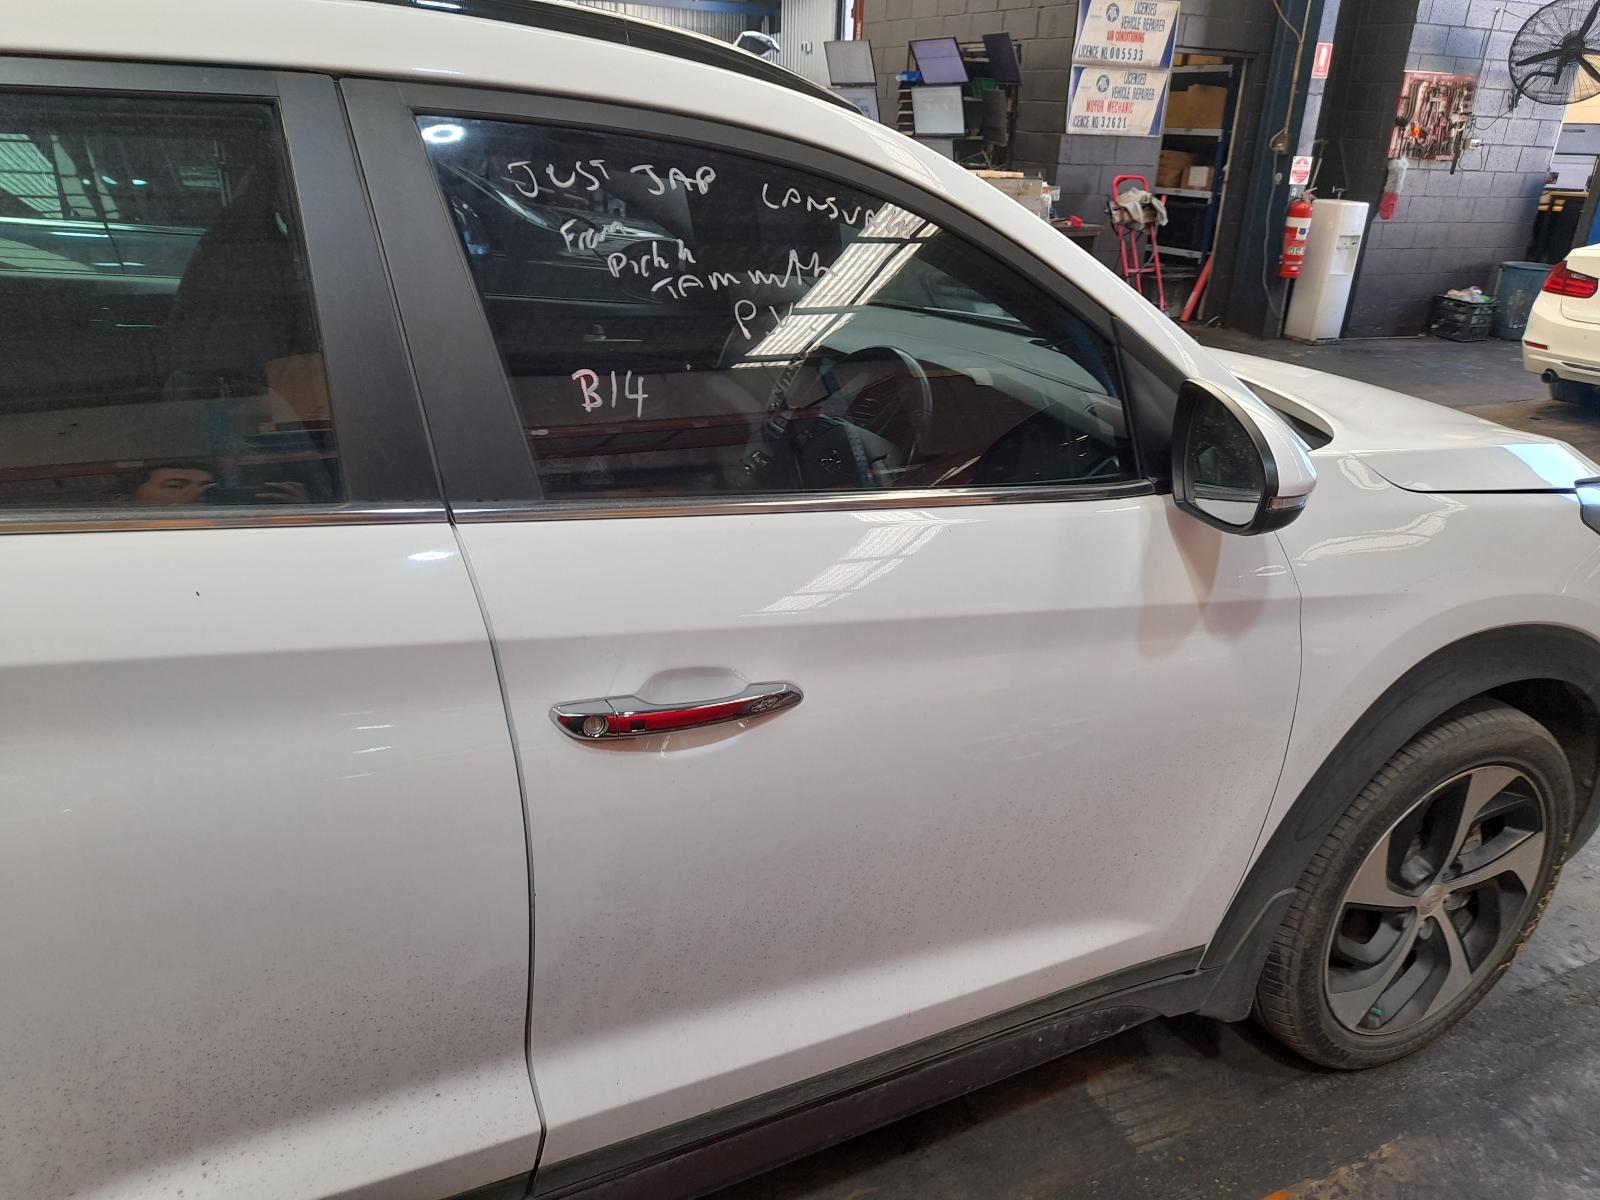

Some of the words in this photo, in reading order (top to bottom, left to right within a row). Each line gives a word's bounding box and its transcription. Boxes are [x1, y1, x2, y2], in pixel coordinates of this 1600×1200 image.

[1134, 2, 1157, 16] LICENSED
[1121, 16, 1140, 30] VEHICLE
[1142, 17, 1165, 32] REPAIRER
[1115, 31, 1145, 43] CONDITIONING
[1109, 47, 1144, 61] 005533
[1111, 86, 1131, 100] VEHICLE
[1132, 87, 1155, 101] REPAIRER
[1085, 99, 1104, 113] MOTOR
[1107, 99, 1134, 114] MECHANIC
[1100, 117, 1127, 129] 32621
[507, 159, 610, 198] JUST
[630, 164, 717, 195] JAP
[572, 368, 649, 418] B14
